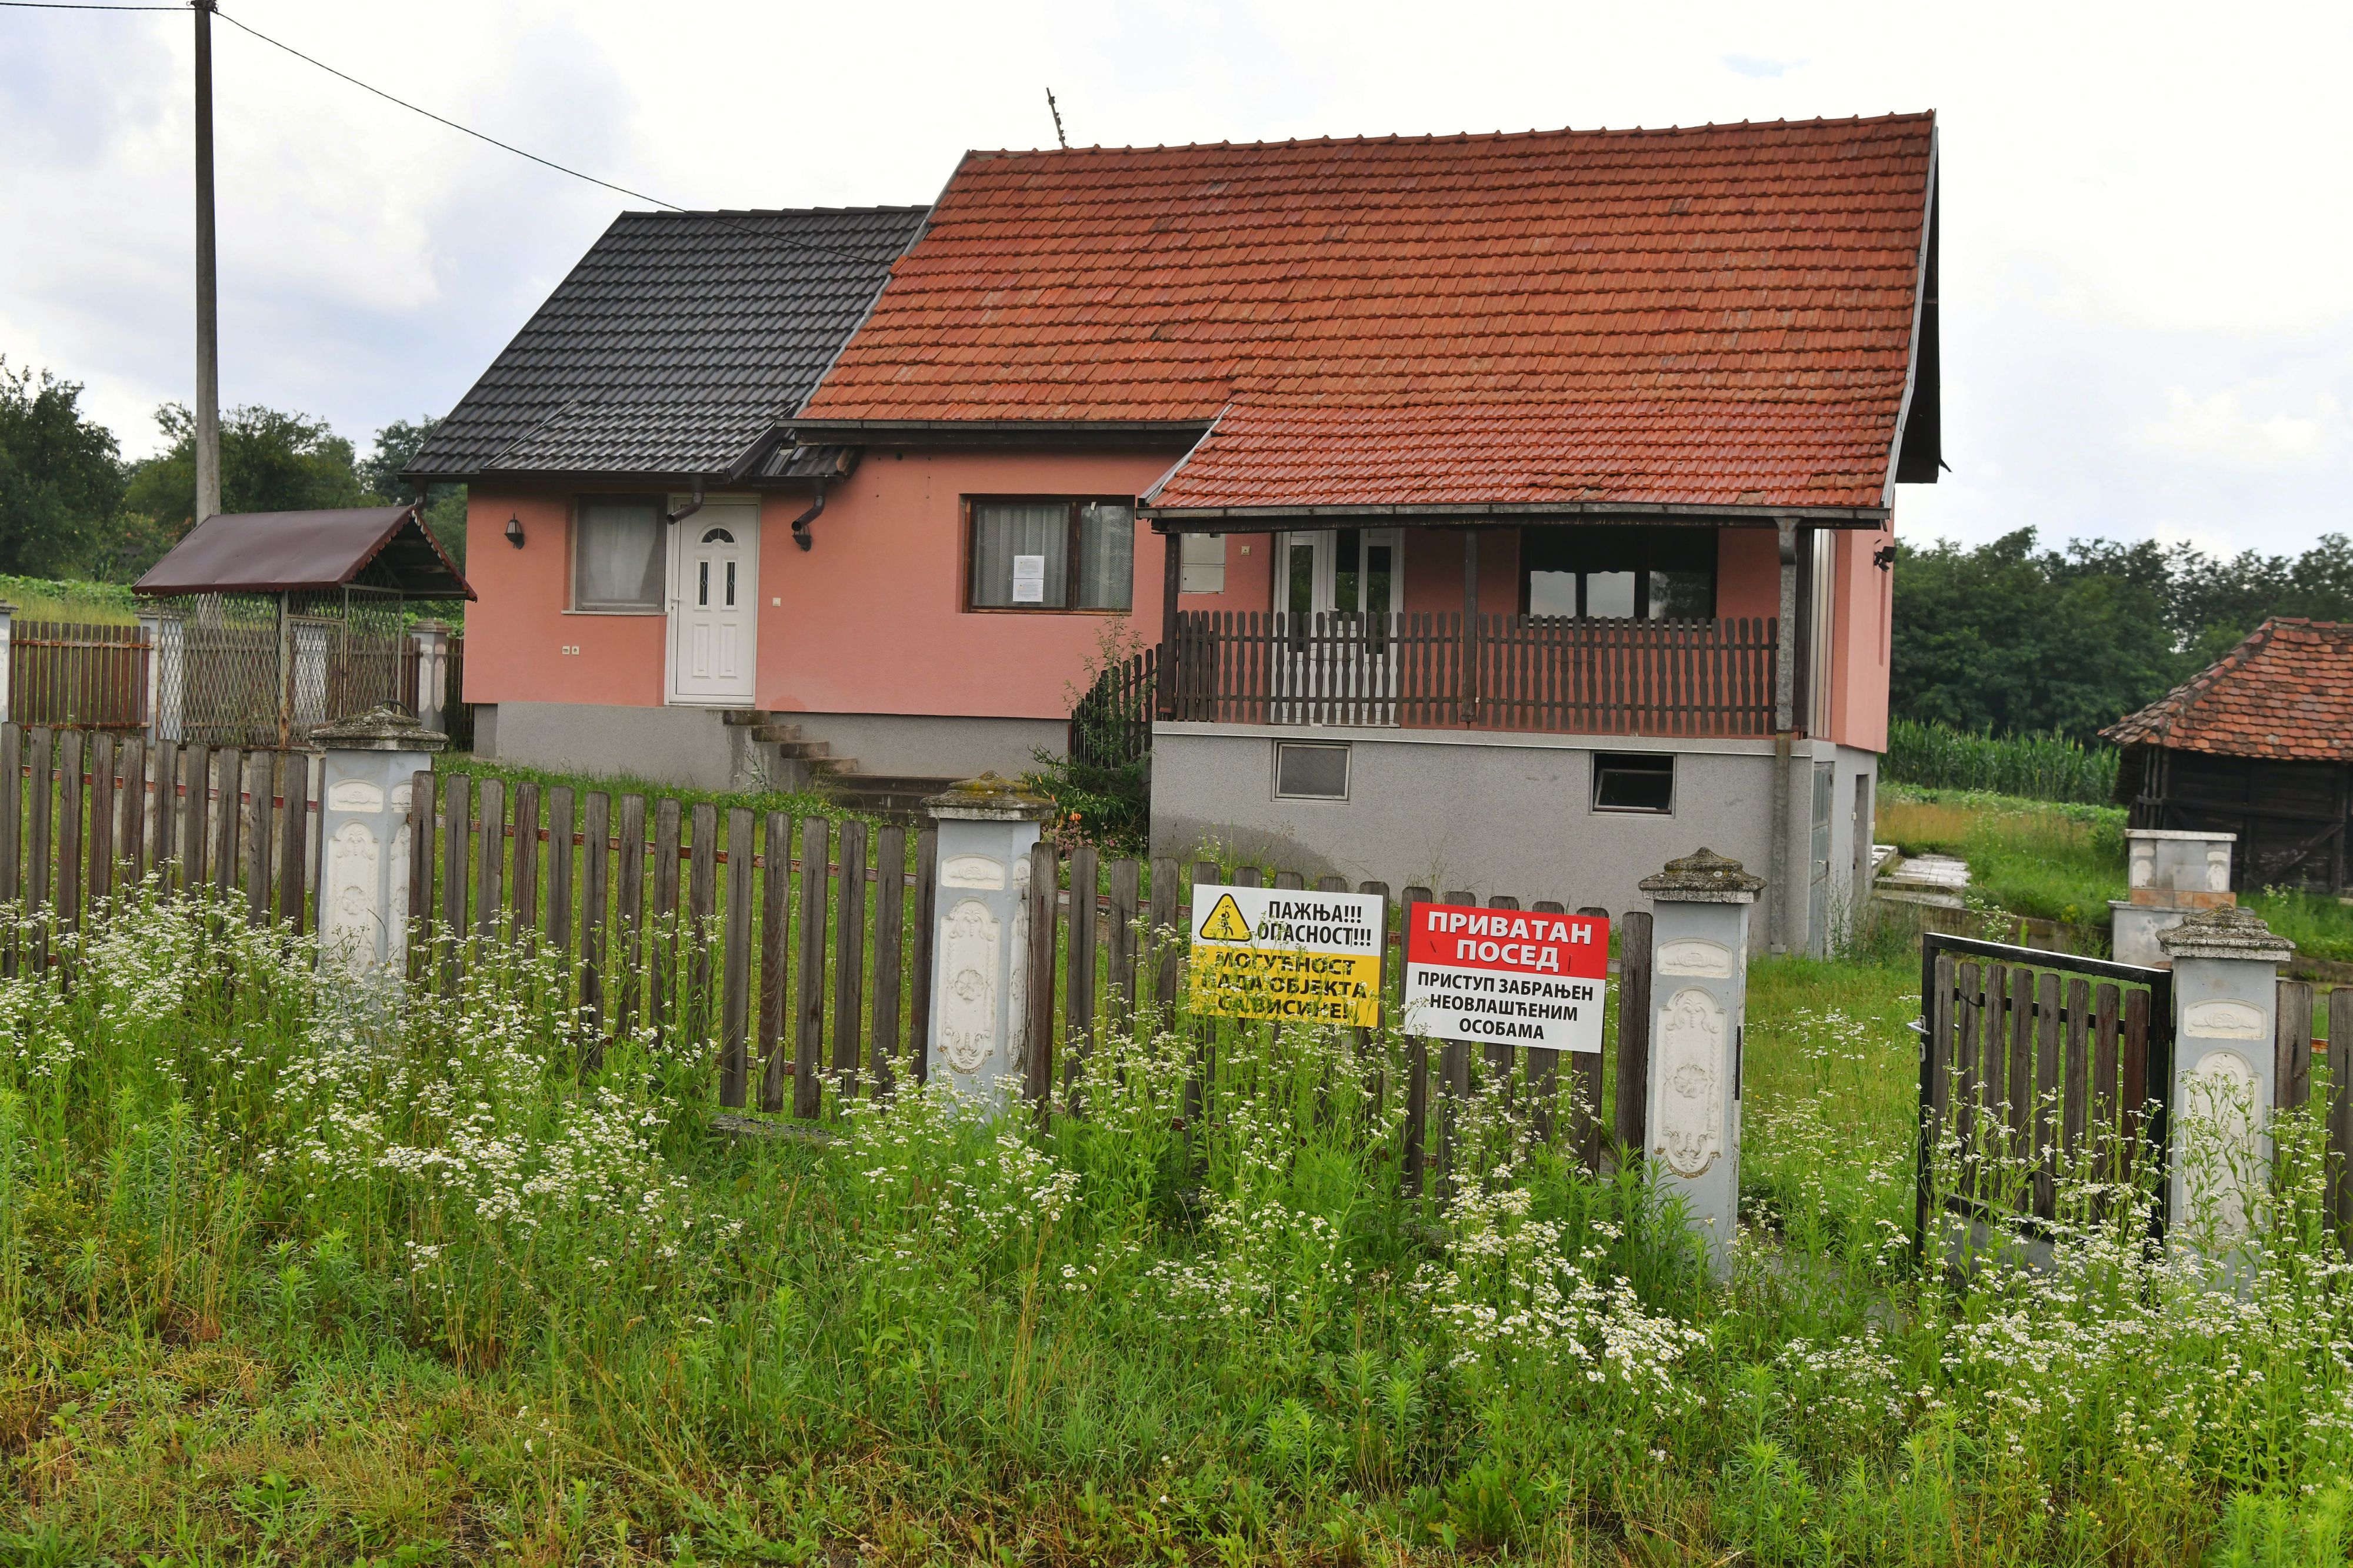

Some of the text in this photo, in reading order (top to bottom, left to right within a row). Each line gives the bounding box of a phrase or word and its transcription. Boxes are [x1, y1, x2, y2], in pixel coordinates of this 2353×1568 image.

[1269, 900, 1362, 923] ПАЖЊА!!!
[1257, 922, 1371, 946] ОПАСНОСТ!!!
[1428, 911, 1592, 945] ПРИВАТАН
[1215, 951, 1356, 975] МОГУЋНОСТ
[1457, 939, 1559, 972] ПОСЕД
[1269, 976, 1367, 999] ОБЈЕКТА
[1418, 971, 1594, 1001] ПРИСТУП ЗАБРАЊЕН
[1429, 993, 1578, 1022] НЕОВЛАШЋЕНИМ
[1459, 1017, 1544, 1040] ОСОБАМА
